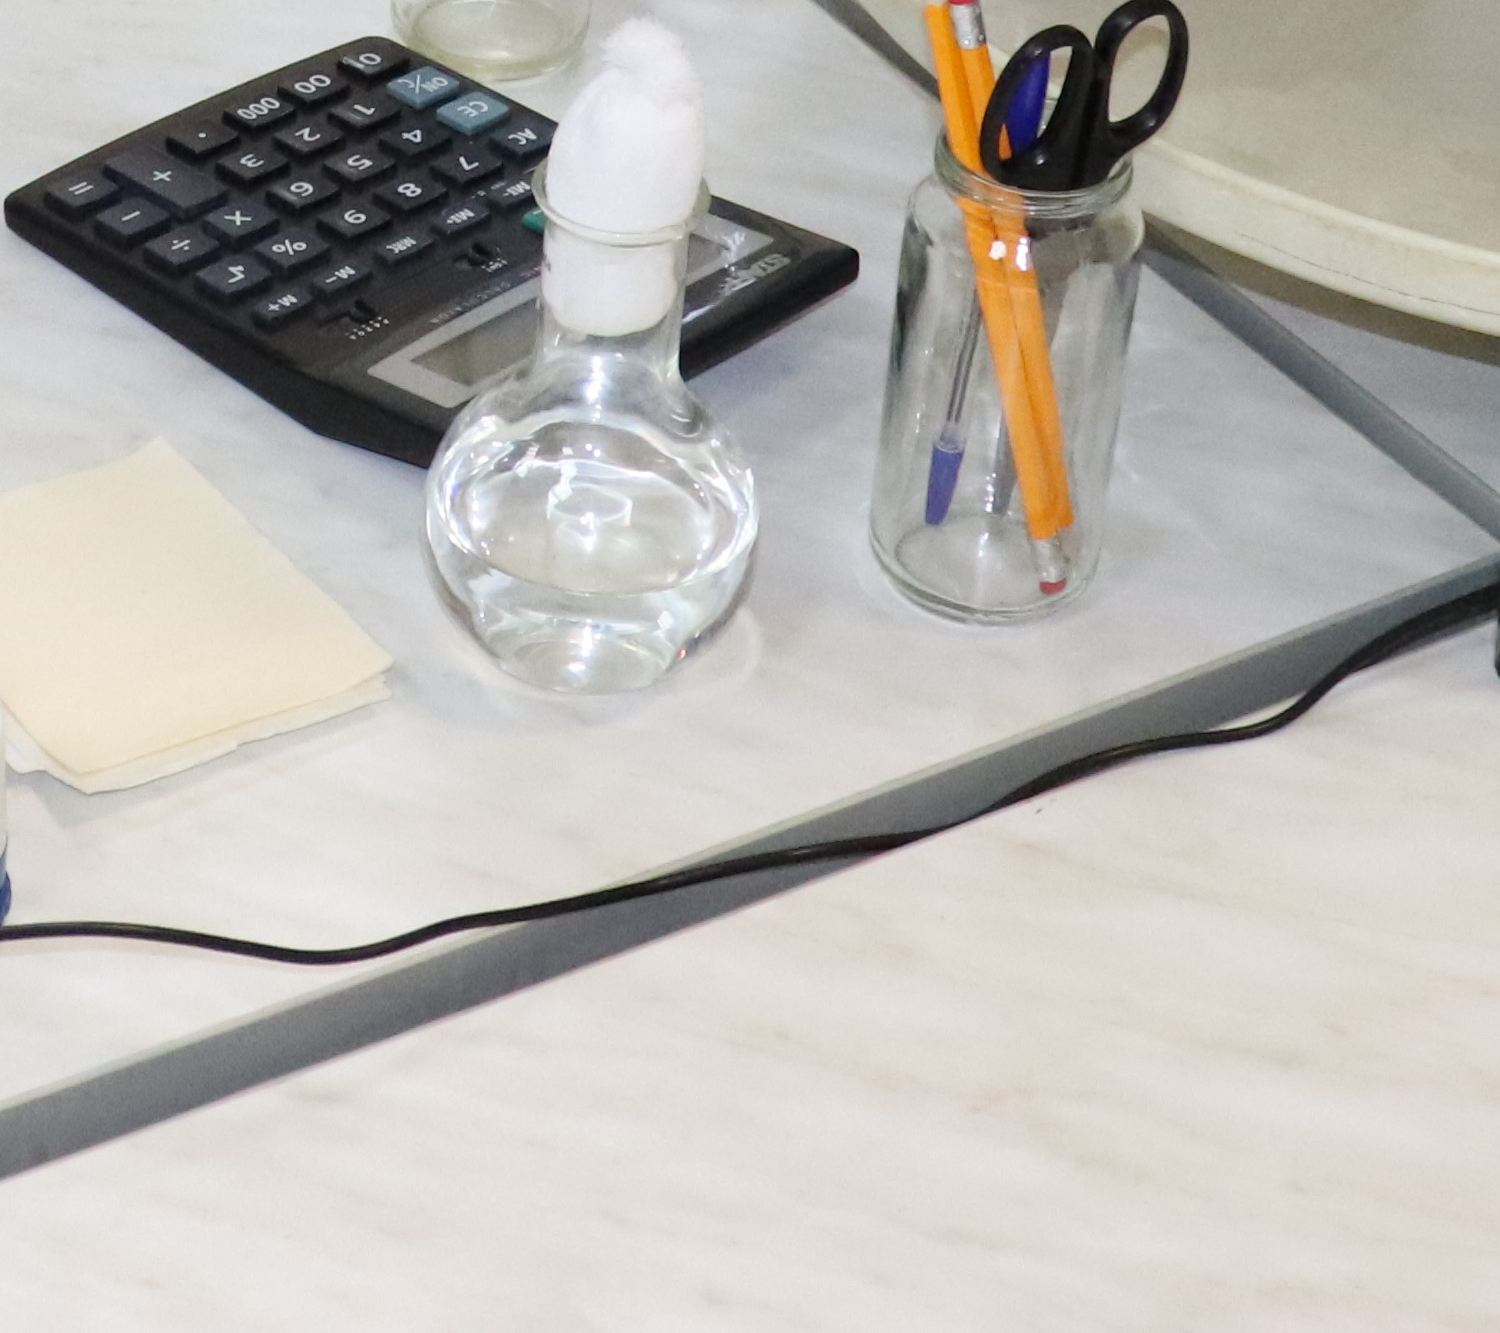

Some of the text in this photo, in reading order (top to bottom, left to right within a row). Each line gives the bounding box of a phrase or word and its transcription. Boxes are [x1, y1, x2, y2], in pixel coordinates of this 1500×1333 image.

[236, 96, 281, 121] 000
[457, 101, 488, 117] CE
[296, 126, 321, 142] 2
[402, 129, 422, 143] 4
[508, 128, 537, 145] AC
[240, 153, 265, 170] 3
[347, 154, 373, 171] 5
[459, 156, 479, 170] 7
[397, 183, 422, 198] 8
